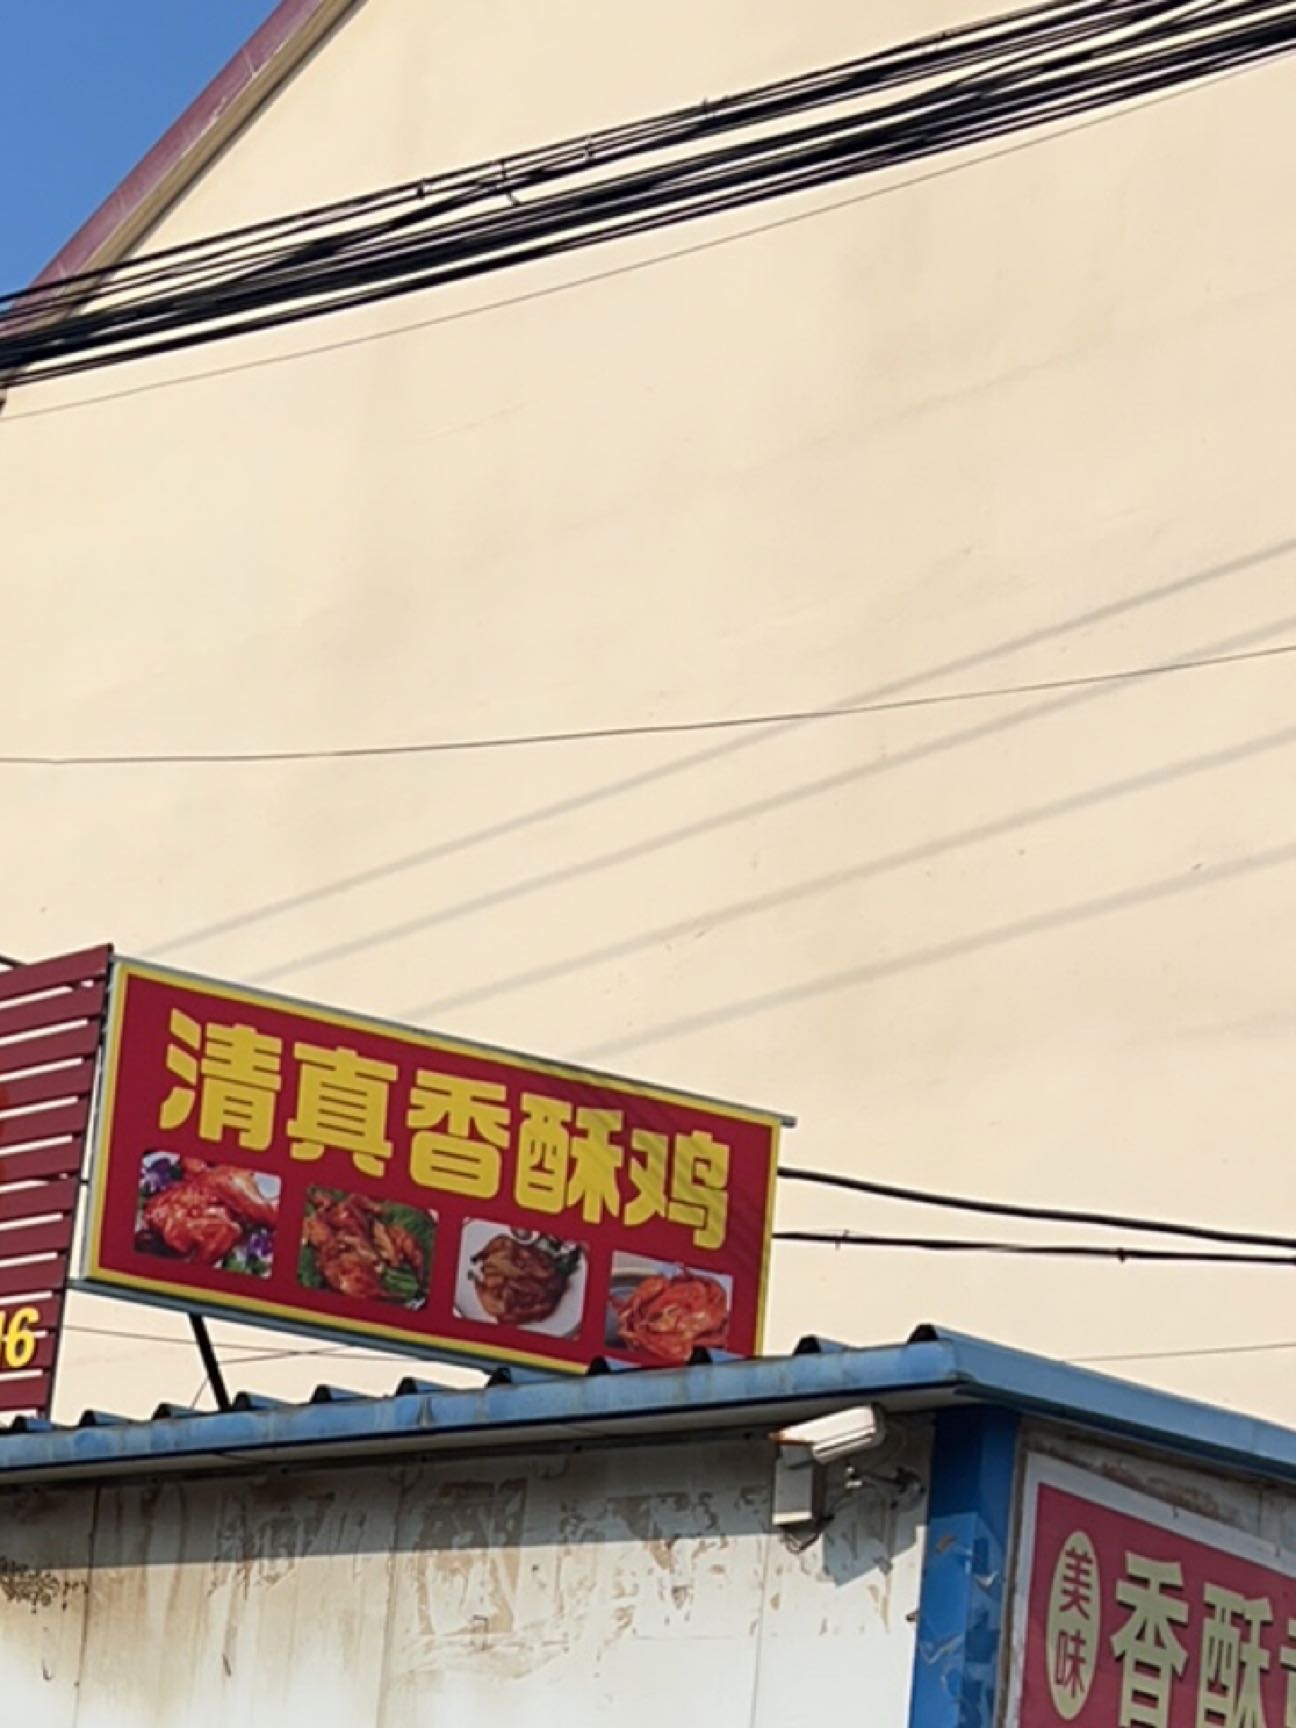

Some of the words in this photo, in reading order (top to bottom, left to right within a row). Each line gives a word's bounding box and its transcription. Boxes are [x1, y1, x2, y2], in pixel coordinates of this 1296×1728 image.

[157, 1006, 732, 1252] 清真香酥鸡
[1055, 1546, 1094, 1702] 美味
